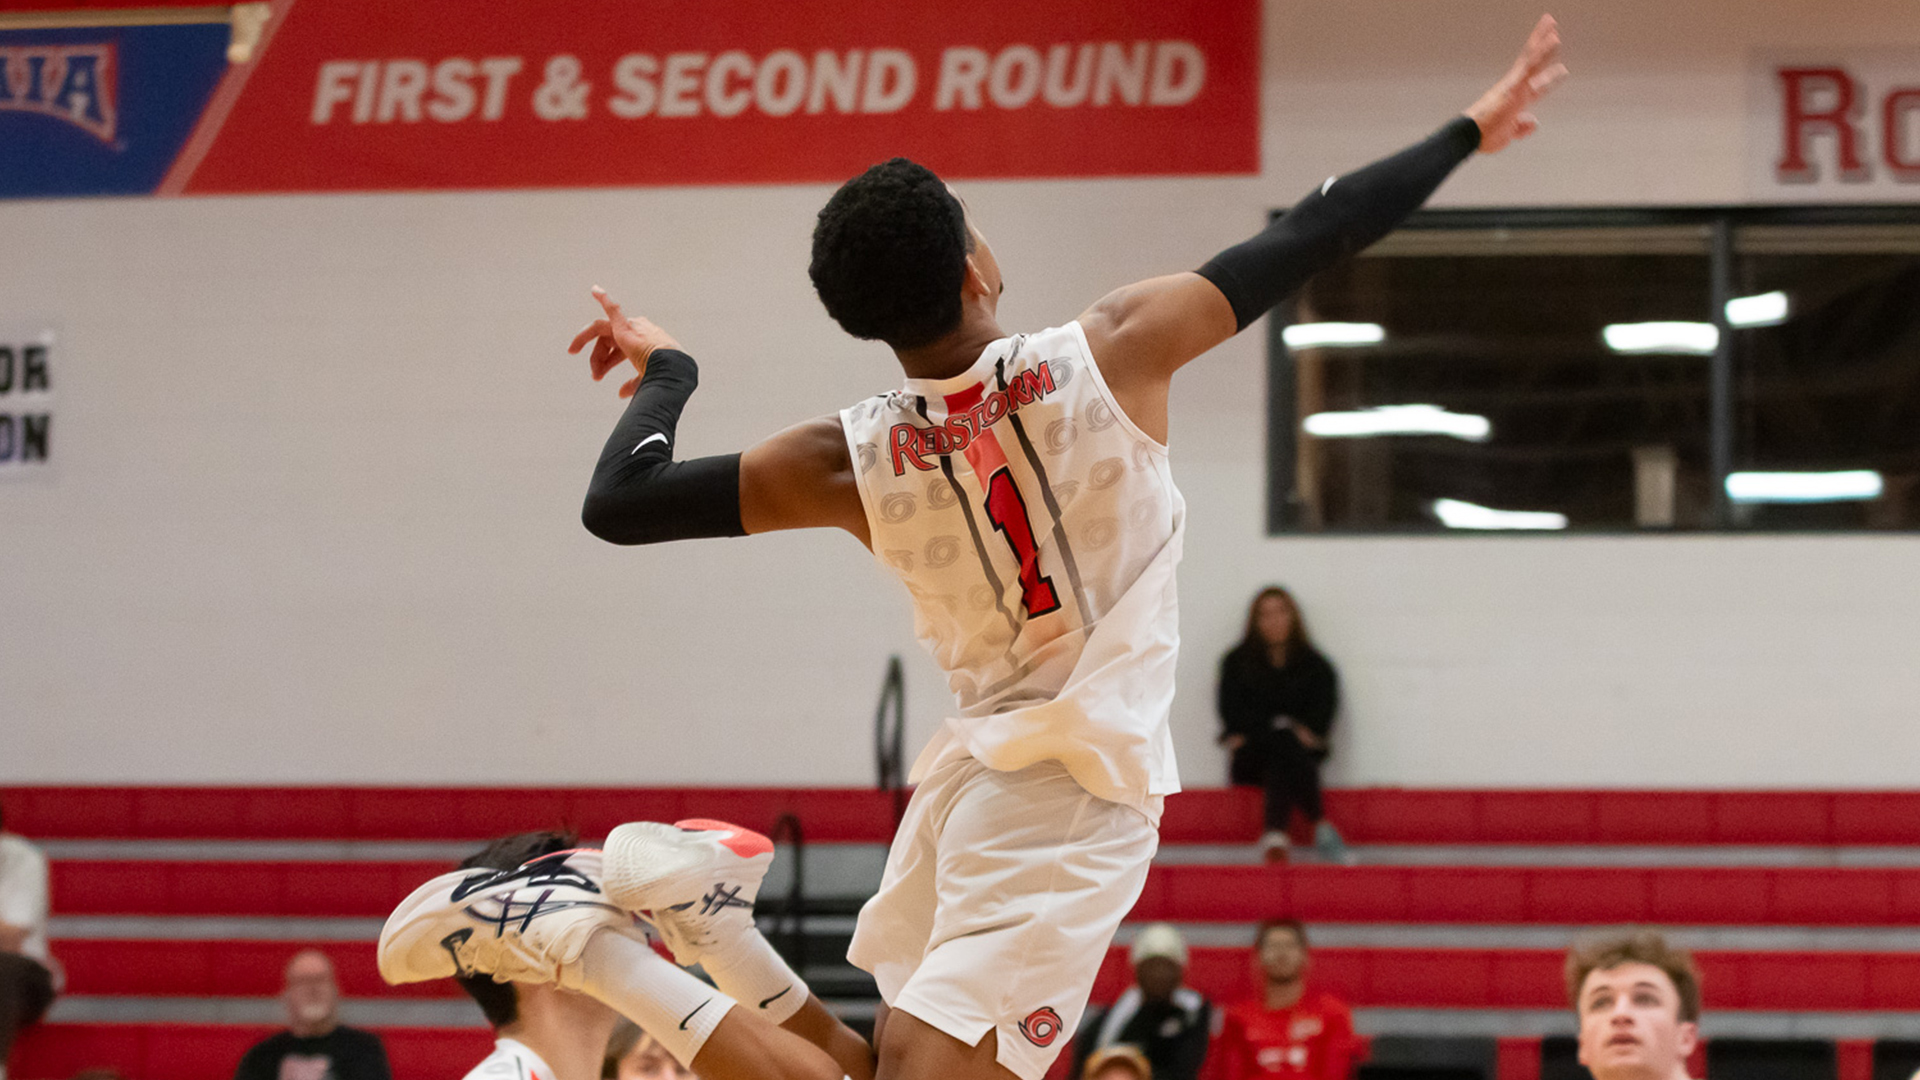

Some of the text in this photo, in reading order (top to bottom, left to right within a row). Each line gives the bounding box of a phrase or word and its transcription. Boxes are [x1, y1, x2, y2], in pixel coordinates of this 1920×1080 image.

[312, 41, 1206, 123] FIRST & SECOND ROUND
[983, 465, 1061, 620] 1
